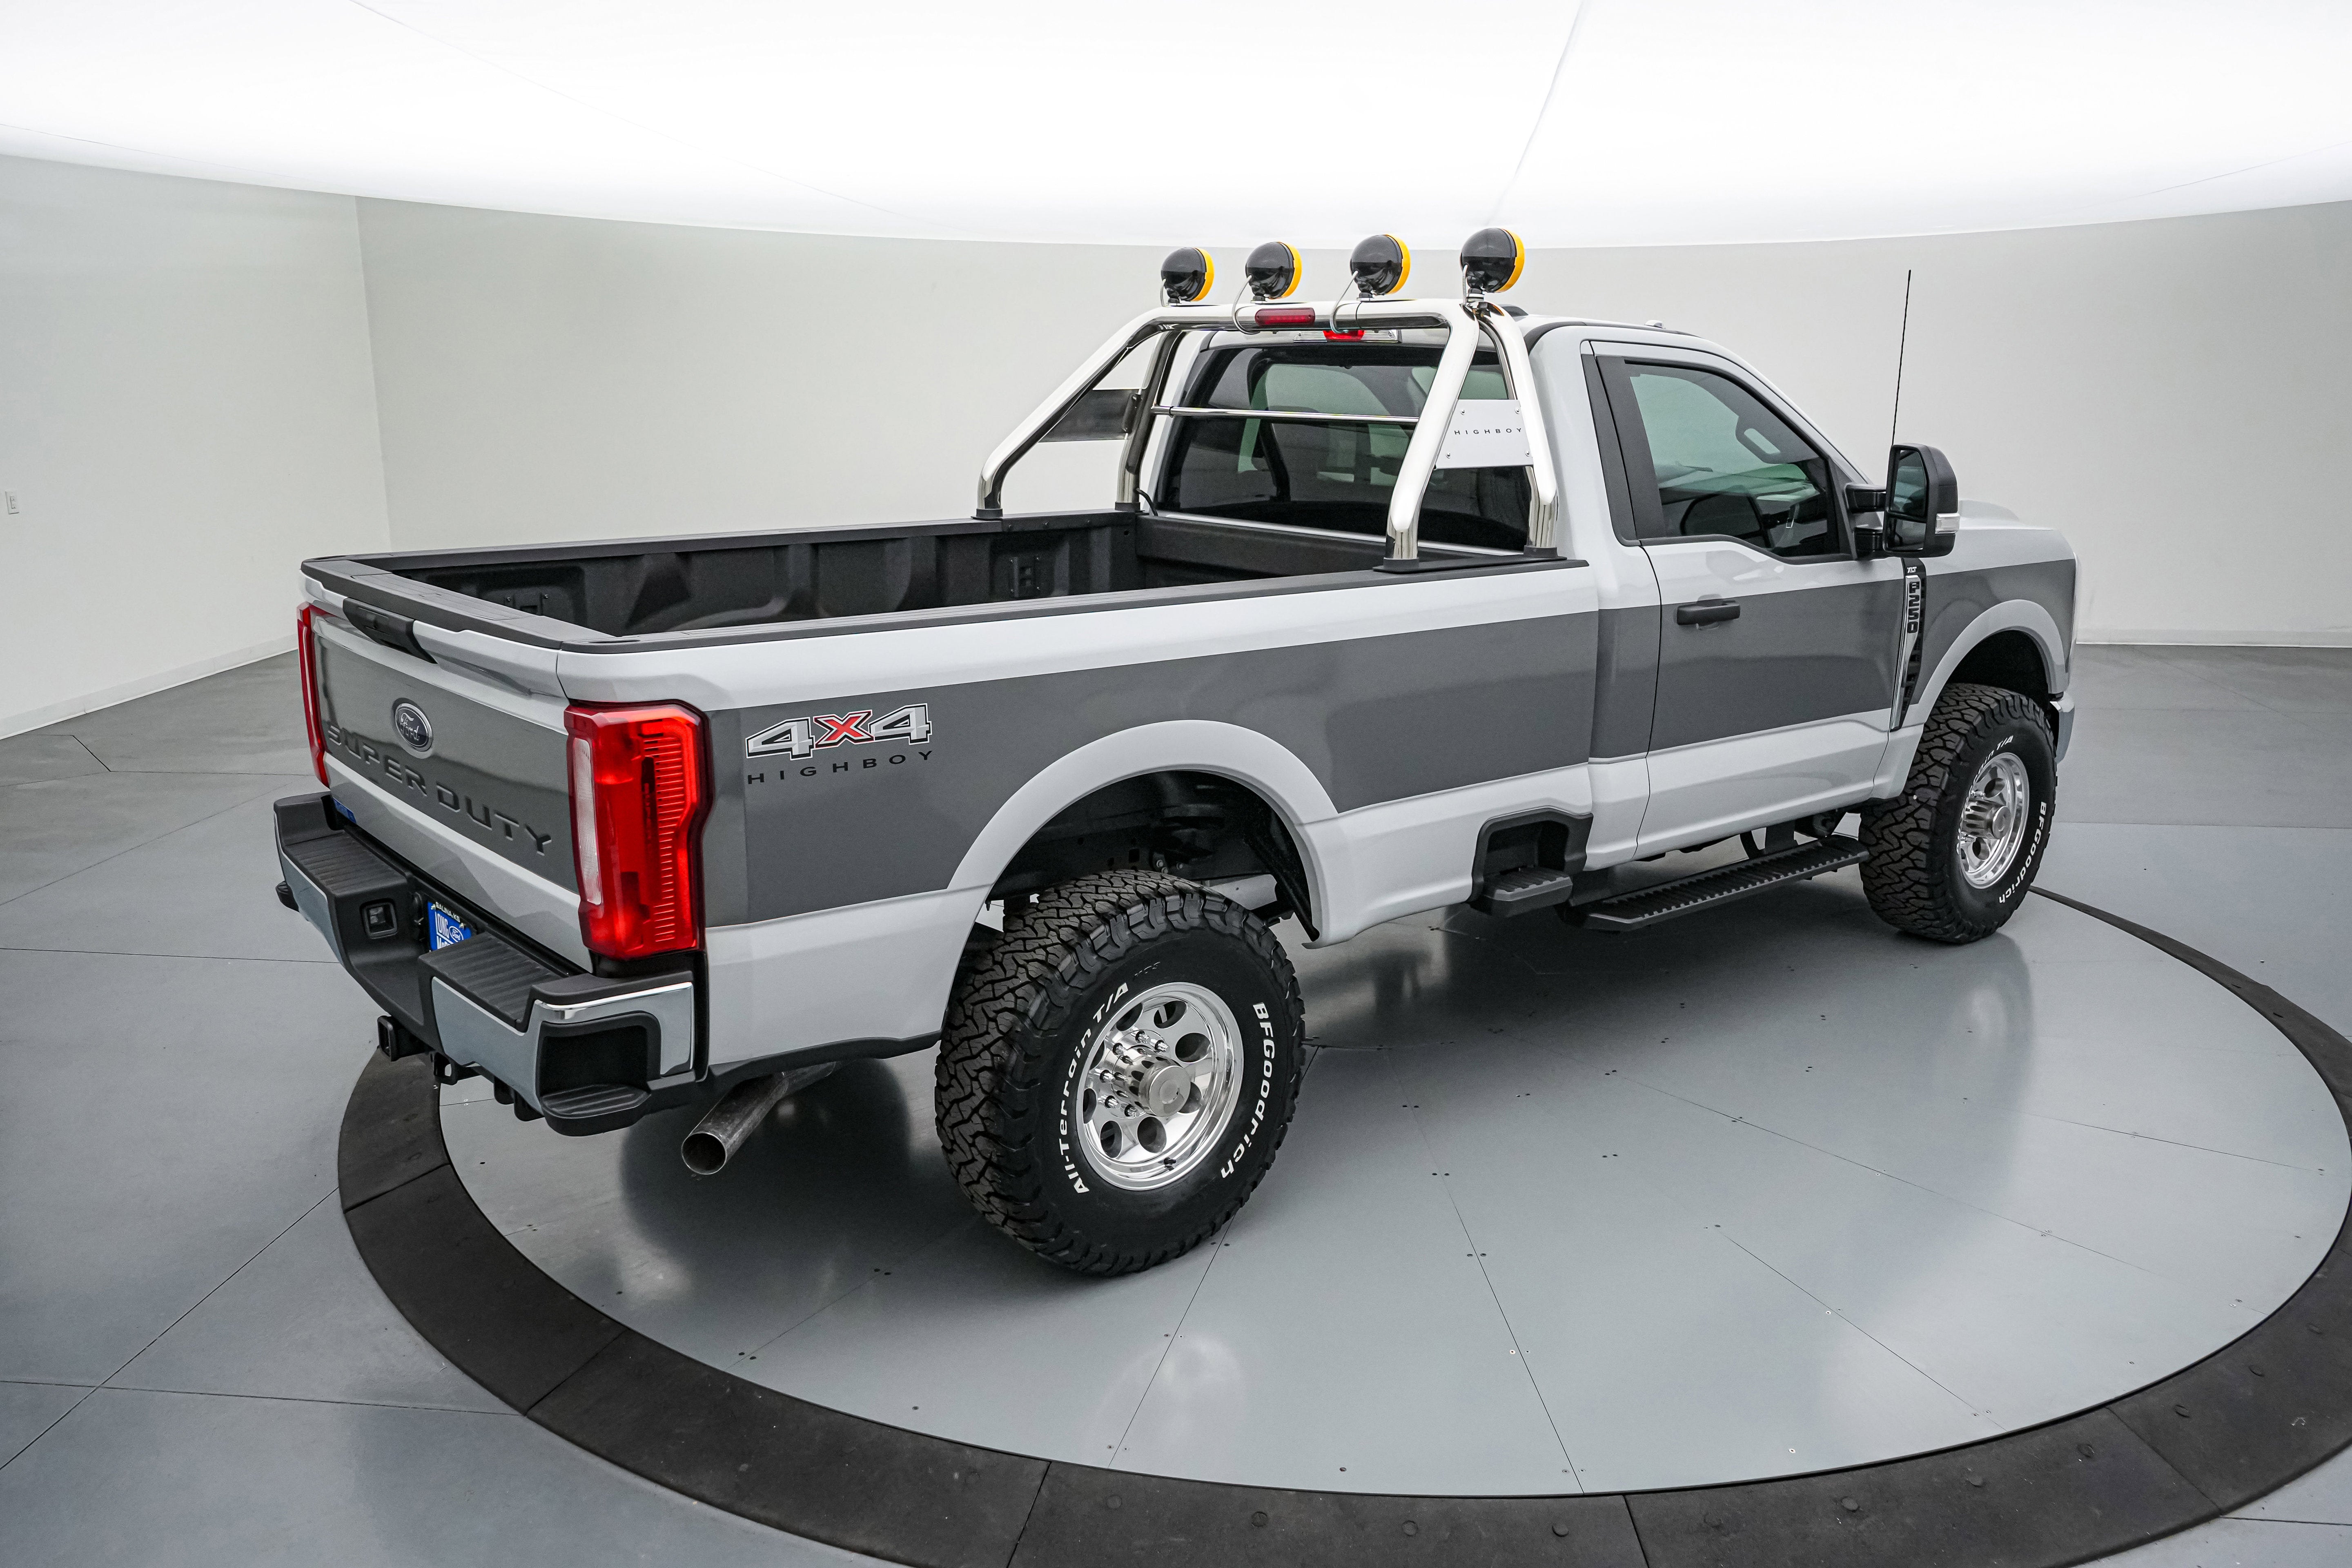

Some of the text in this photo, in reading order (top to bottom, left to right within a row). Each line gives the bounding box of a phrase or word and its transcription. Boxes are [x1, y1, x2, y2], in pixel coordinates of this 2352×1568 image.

[1907, 581, 1920, 634] F250
[327, 725, 552, 856] SUPER DUTY
[747, 750, 933, 784] HIGHBOY
[1999, 802, 2047, 904] BFGoodrich
[1059, 982, 1129, 1193] All-Terrain T/A
[1221, 1002, 1274, 1178] BFGoodrich
